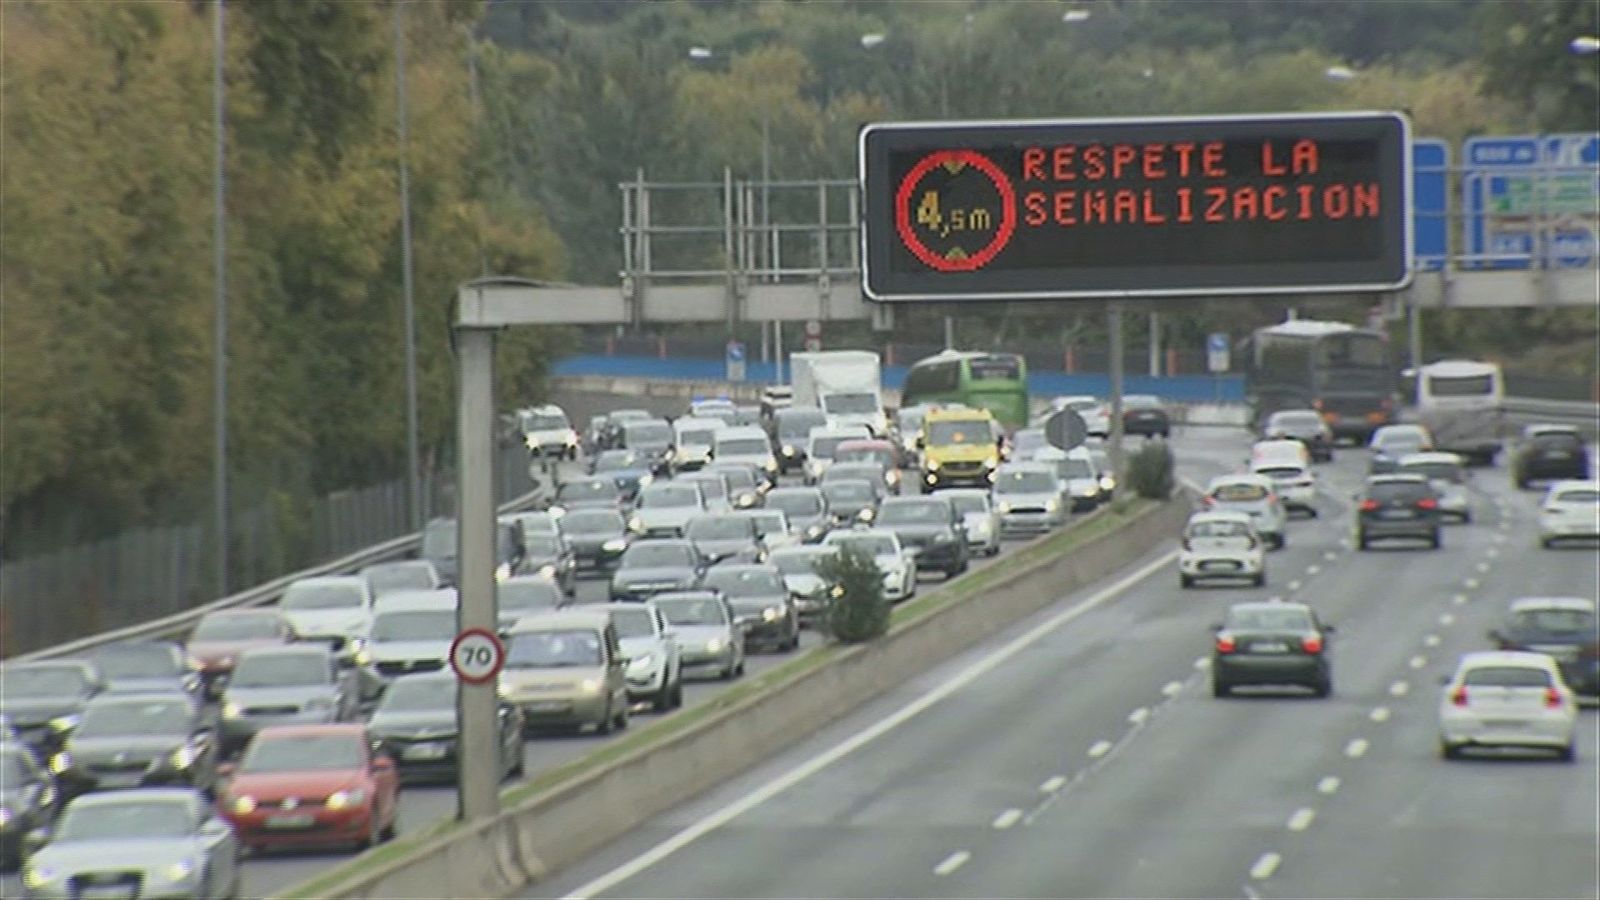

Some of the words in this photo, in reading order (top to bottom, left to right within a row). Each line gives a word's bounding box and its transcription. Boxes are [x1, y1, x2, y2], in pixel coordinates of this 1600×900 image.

[1022, 140, 1226, 181] RESPETE
[1262, 138, 1319, 176] LA
[462, 645, 492, 666] 70
